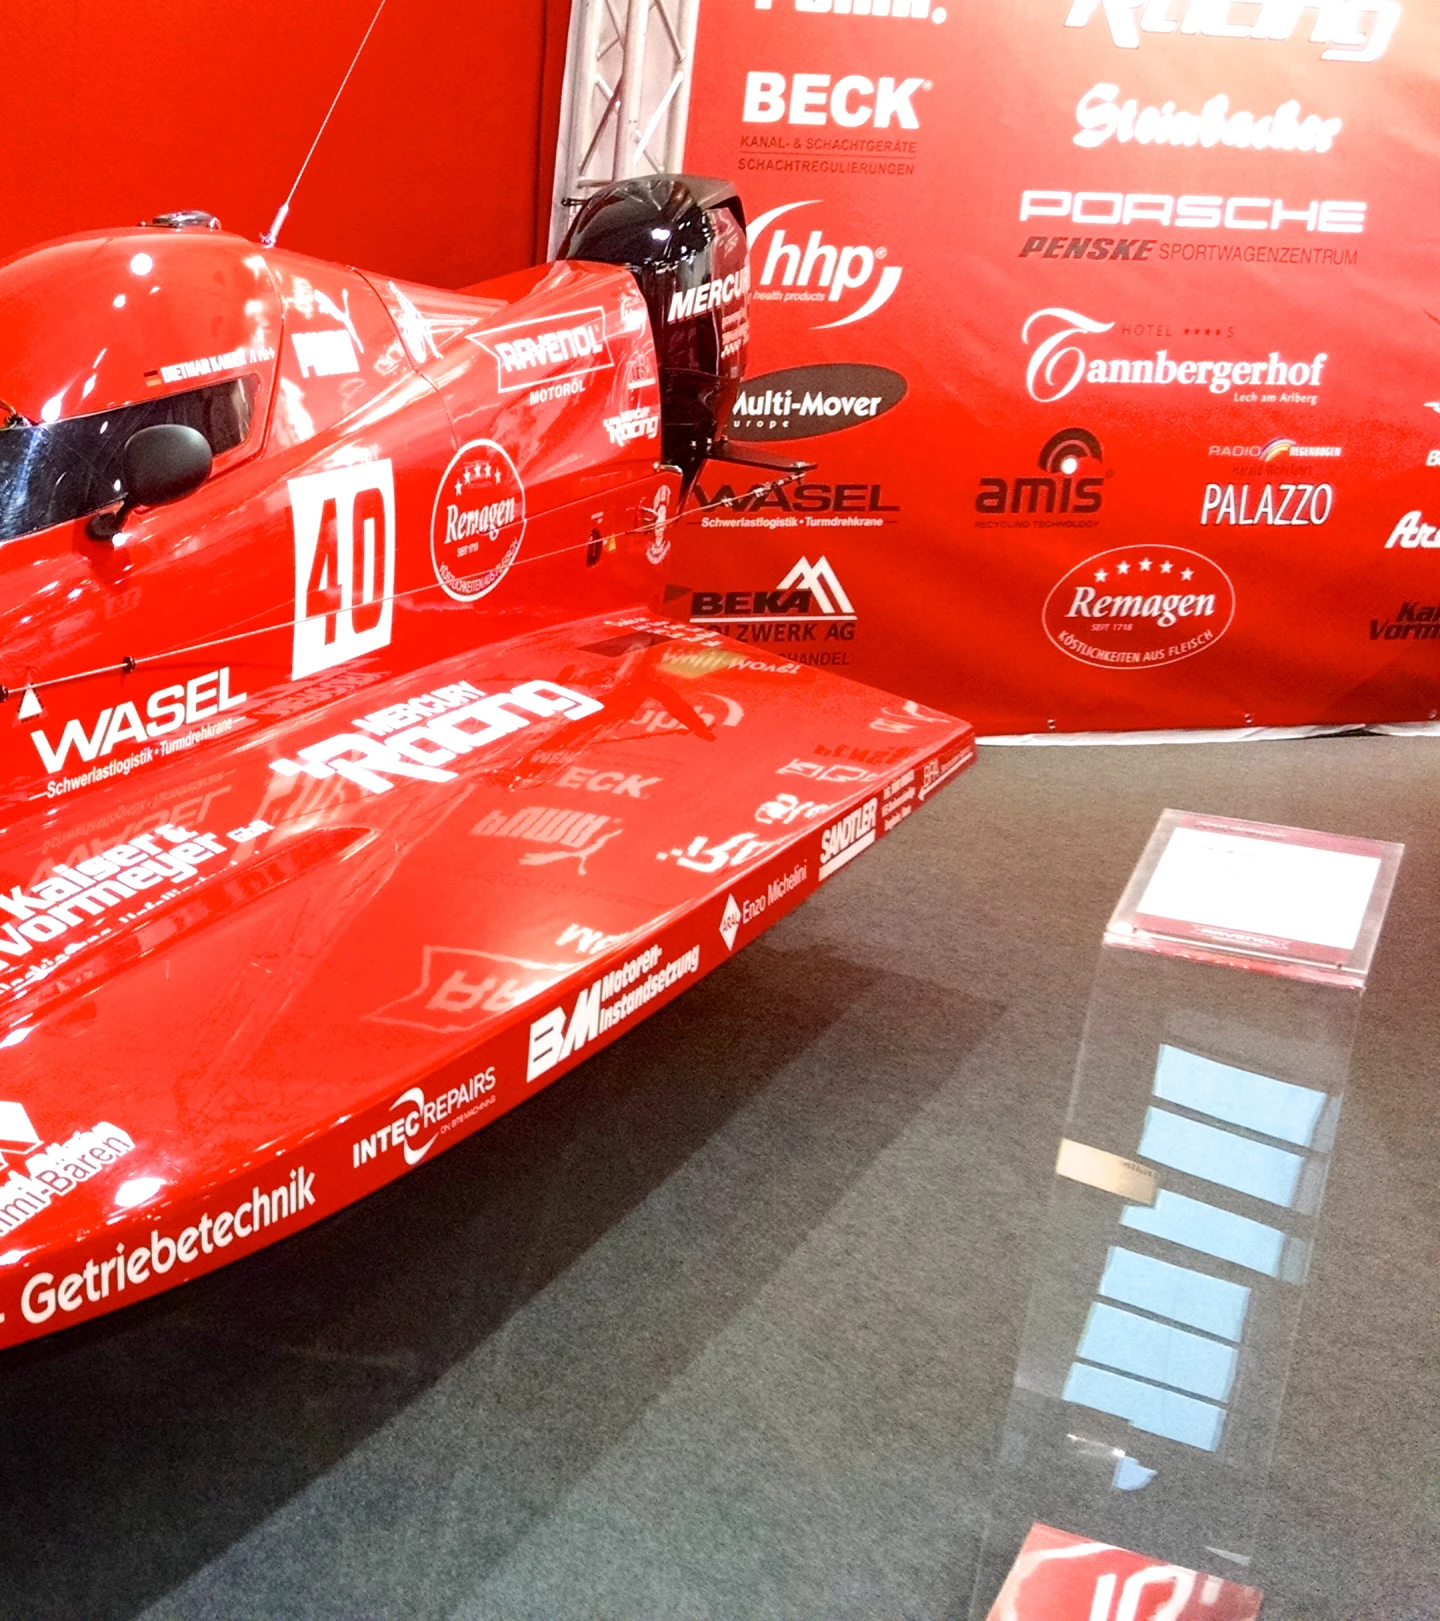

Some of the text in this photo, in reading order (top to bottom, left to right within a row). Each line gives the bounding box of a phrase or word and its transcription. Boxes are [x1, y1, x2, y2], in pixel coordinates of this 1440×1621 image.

[742, 71, 926, 129] BECK
[740, 135, 917, 153] KANAL- & SCHACHTGERÄTE
[738, 158, 915, 175] SCHACHTREGULIERUNGEN
[1019, 190, 1367, 233] PORSCHE
[760, 229, 875, 302] hhp
[1018, 236, 1359, 266] PENSKE SPORTWAGENZENTRUM
[753, 290, 826, 303] health products
[494, 324, 603, 373] RAVENOL
[1121, 324, 1173, 338] HOTEL
[1021, 307, 1327, 402] Tannbergerhof
[529, 378, 586, 405] MOTORÖL
[732, 389, 882, 416] Multi-Mover
[1233, 392, 1318, 406] Lech am Arlberg
[604, 415, 659, 447] Racing
[733, 419, 790, 429] urope
[1208, 445, 1260, 458] RADIO
[692, 483, 901, 513] WASEL
[975, 476, 1105, 514] amis
[1199, 482, 1334, 527] PALAZZO
[444, 496, 516, 544] Remagen
[701, 516, 883, 530] Schwerlastlogistik Turmdrehkrane
[974, 520, 1101, 529] RECYCLING TECHNOLOGY
[305, 486, 387, 647] 40
[690, 591, 812, 615] BEKA
[1064, 586, 1216, 628] Remagen
[697, 622, 818, 643] OLZWERK
[824, 622, 855, 642] AG
[1057, 629, 1214, 663] KÖSTLICHKEITEN AUS FLEISCH
[30, 666, 248, 774] WASEL
[351, 680, 487, 737] MERCURY
[267, 679, 605, 795] Racing
[46, 716, 233, 799] Schwerlastlogistik Turmdrehkrane
[154, 822, 201, 854] &
[819, 796, 878, 864] SANDTLER
[742, 859, 808, 925] Enzo Michelini
[721, 912, 741, 933] ARAL
[601, 944, 663, 1003] Motoren-
[526, 979, 602, 1084] BM
[352, 1065, 497, 1169] INTEC REPAIRS
[20, 1165, 318, 1326] Getriebetechnik
